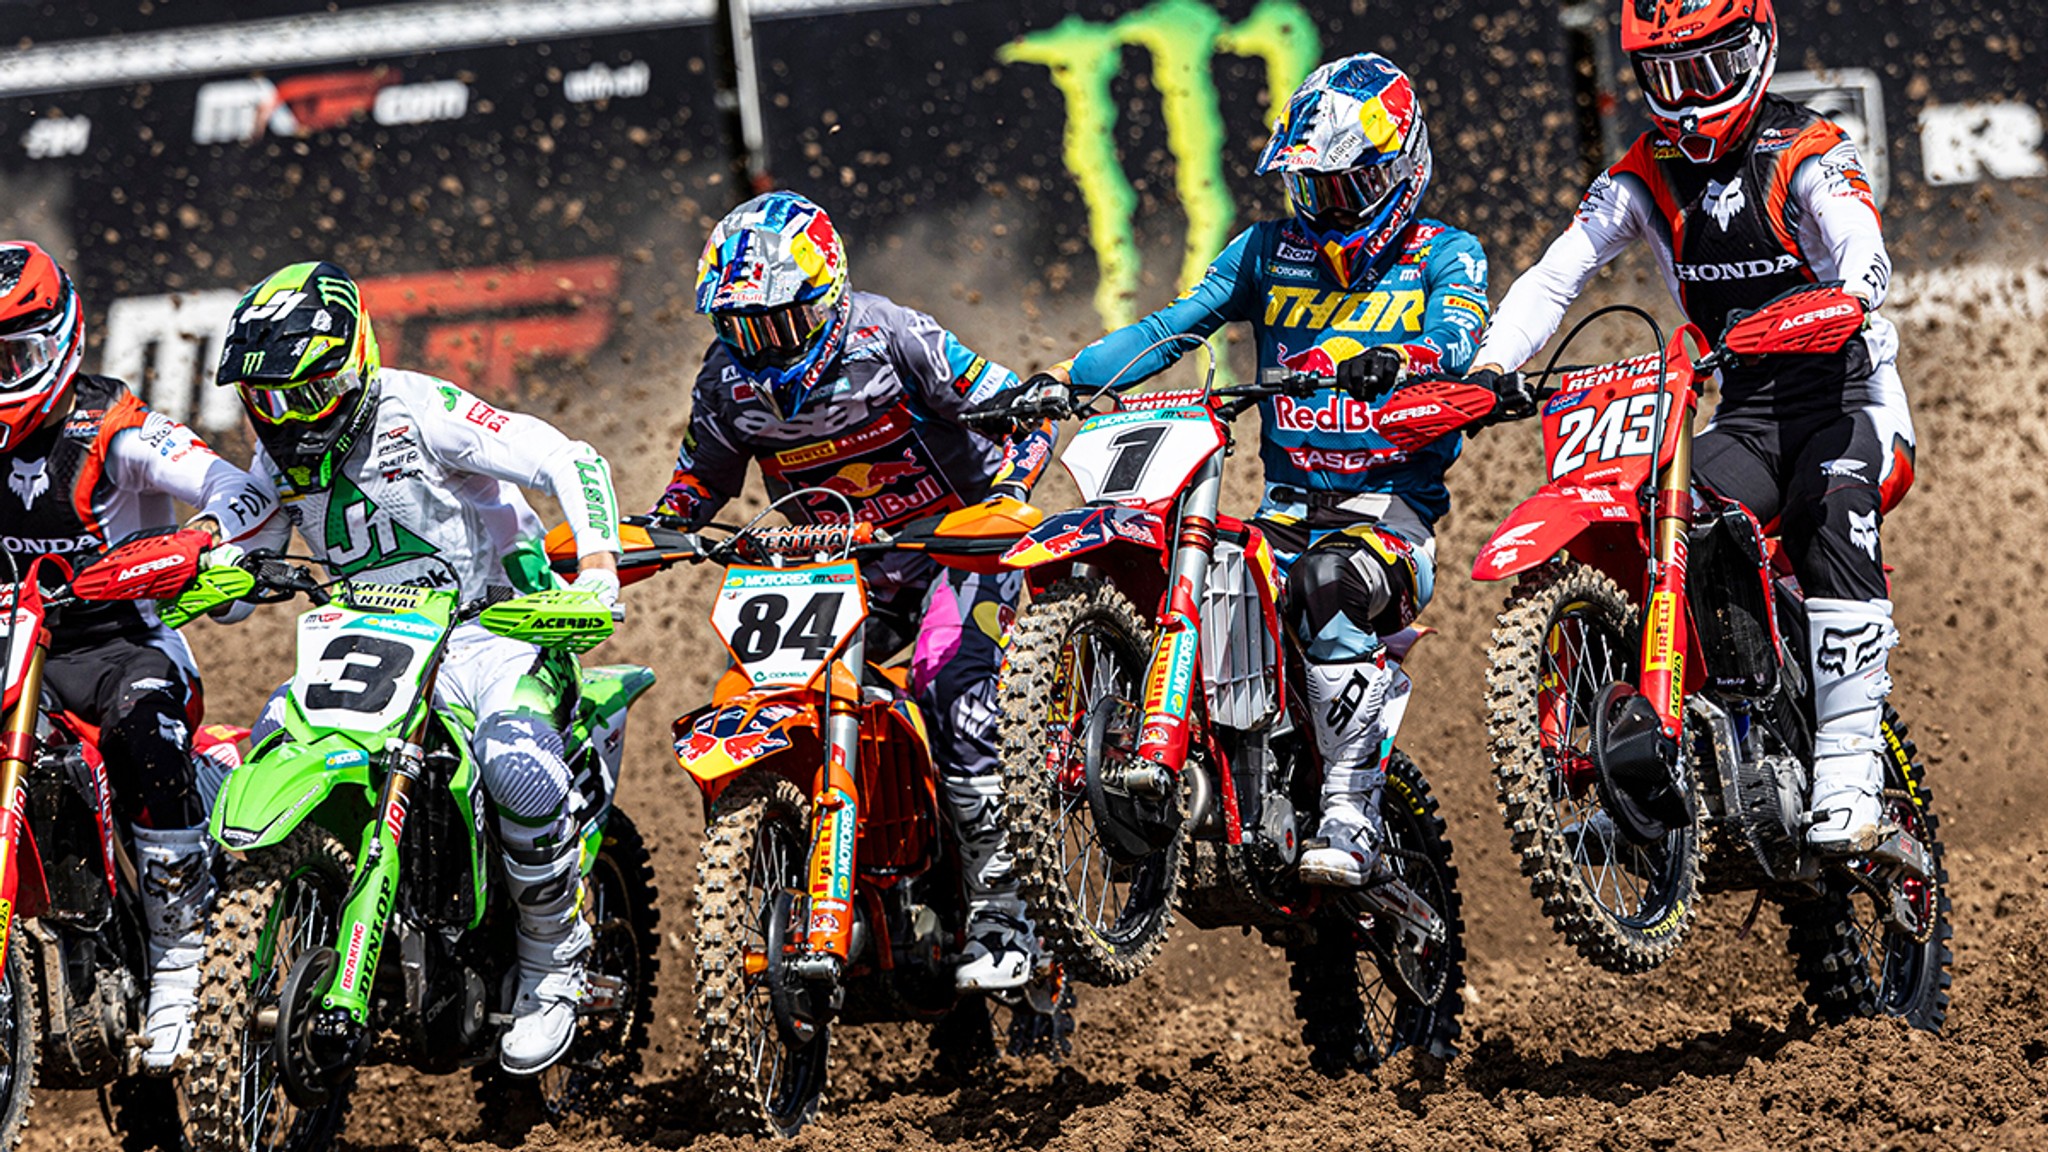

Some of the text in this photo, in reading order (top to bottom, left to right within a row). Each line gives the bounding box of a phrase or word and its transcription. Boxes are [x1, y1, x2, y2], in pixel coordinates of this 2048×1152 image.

[1328, 134, 1359, 164] AIROH
[1675, 254, 1803, 282] HONDA
[1264, 285, 1426, 333] THOR
[1778, 303, 1856, 331] ACERBIS
[1567, 359, 1661, 392] RENTHA
[1274, 396, 1338, 431] Red
[1380, 404, 1442, 425] ACERBIS
[1551, 391, 1674, 480] 243
[1098, 423, 1172, 498] 1
[1288, 449, 1406, 473] GASGAS
[574, 457, 611, 540] JUST1
[814, 474, 943, 528] Red Bull
[0, 533, 102, 555] ONDA
[117, 554, 186, 582] ACERBIS
[338, 592, 418, 609] RNTHAL
[745, 573, 833, 587] MOTOREX
[812, 573, 854, 584] MXGP
[530, 616, 606, 630] ACERBIS
[731, 591, 846, 664] 84
[1650, 599, 1671, 663] PIRELLI
[305, 634, 414, 714] 3
[1145, 634, 1172, 709] PIRELLI
[1174, 628, 1197, 696] MOTOREX
[812, 814, 833, 894] PIRELLI
[838, 803, 855, 876] MOTOREX
[342, 923, 364, 990] BRAKING
[356, 876, 391, 999] DUNLOP
